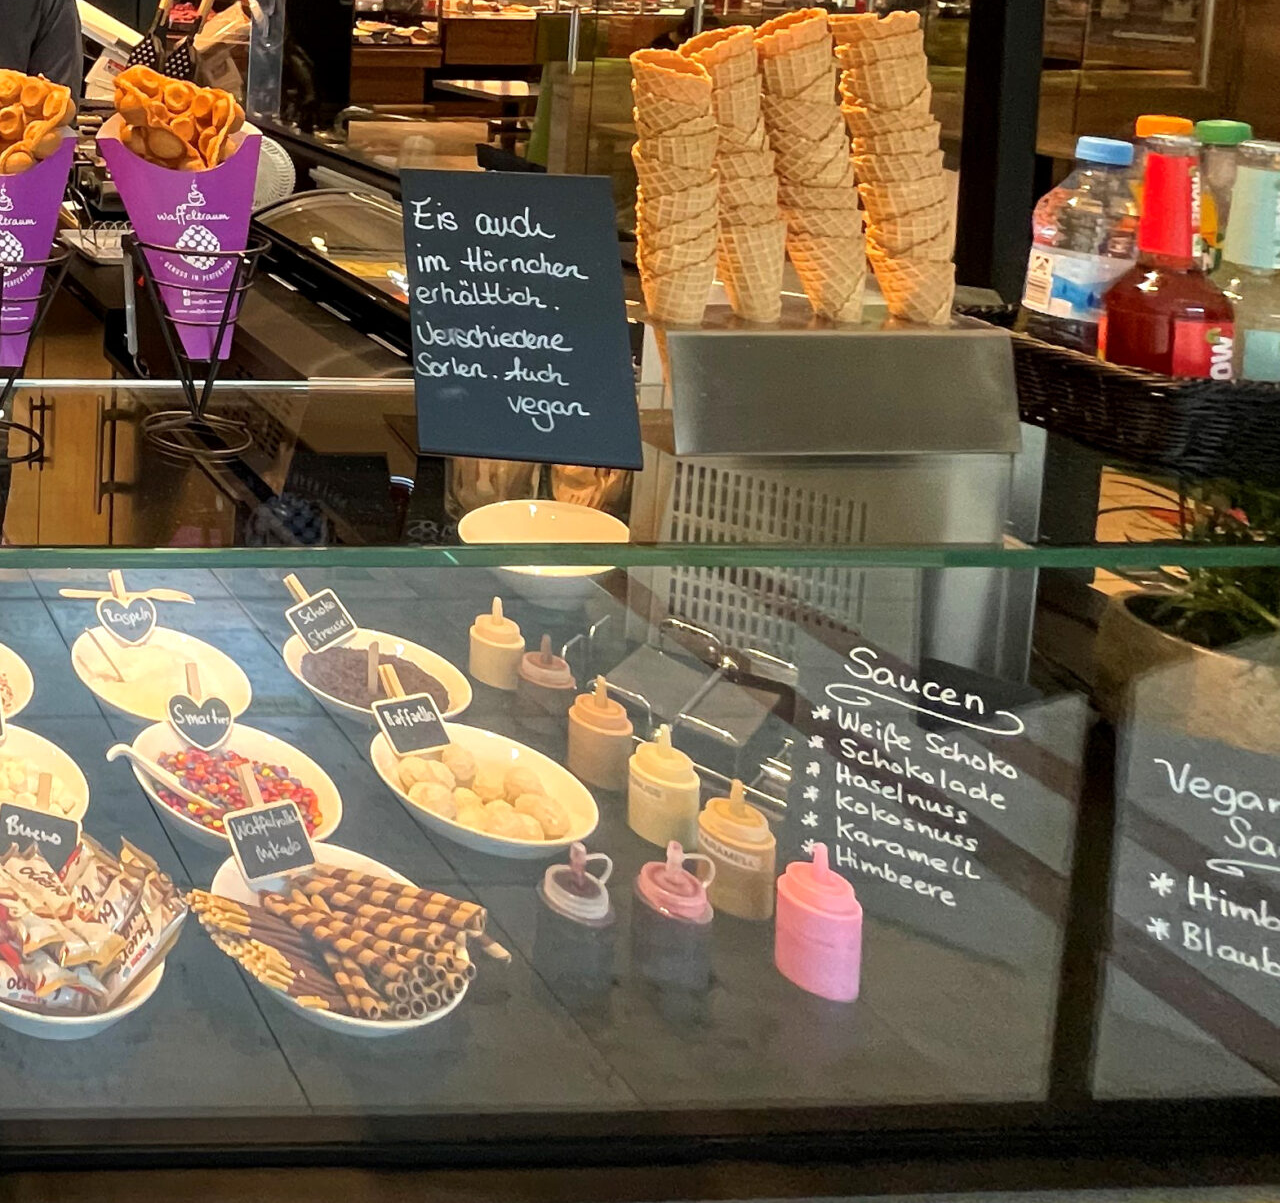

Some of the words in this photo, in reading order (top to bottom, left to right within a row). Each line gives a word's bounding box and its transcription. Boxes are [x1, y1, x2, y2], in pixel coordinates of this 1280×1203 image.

[156, 202, 230, 226] waffeltraum
[410, 196, 459, 231] Eis
[475, 206, 557, 239] auch
[416, 243, 452, 273] im
[460, 246, 589, 280] Hörnchen
[504, 356, 570, 386] Auch
[507, 395, 591, 433] vegan
[844, 647, 984, 715] Saucen
[838, 738, 1007, 810] Schokolade
[925, 732, 1018, 780] Schoko
[835, 761, 969, 825] Haselnuss
[5, 814, 62, 846] Bueno
[835, 789, 979, 852] Kokosnuss
[835, 844, 958, 907] Himbeere
